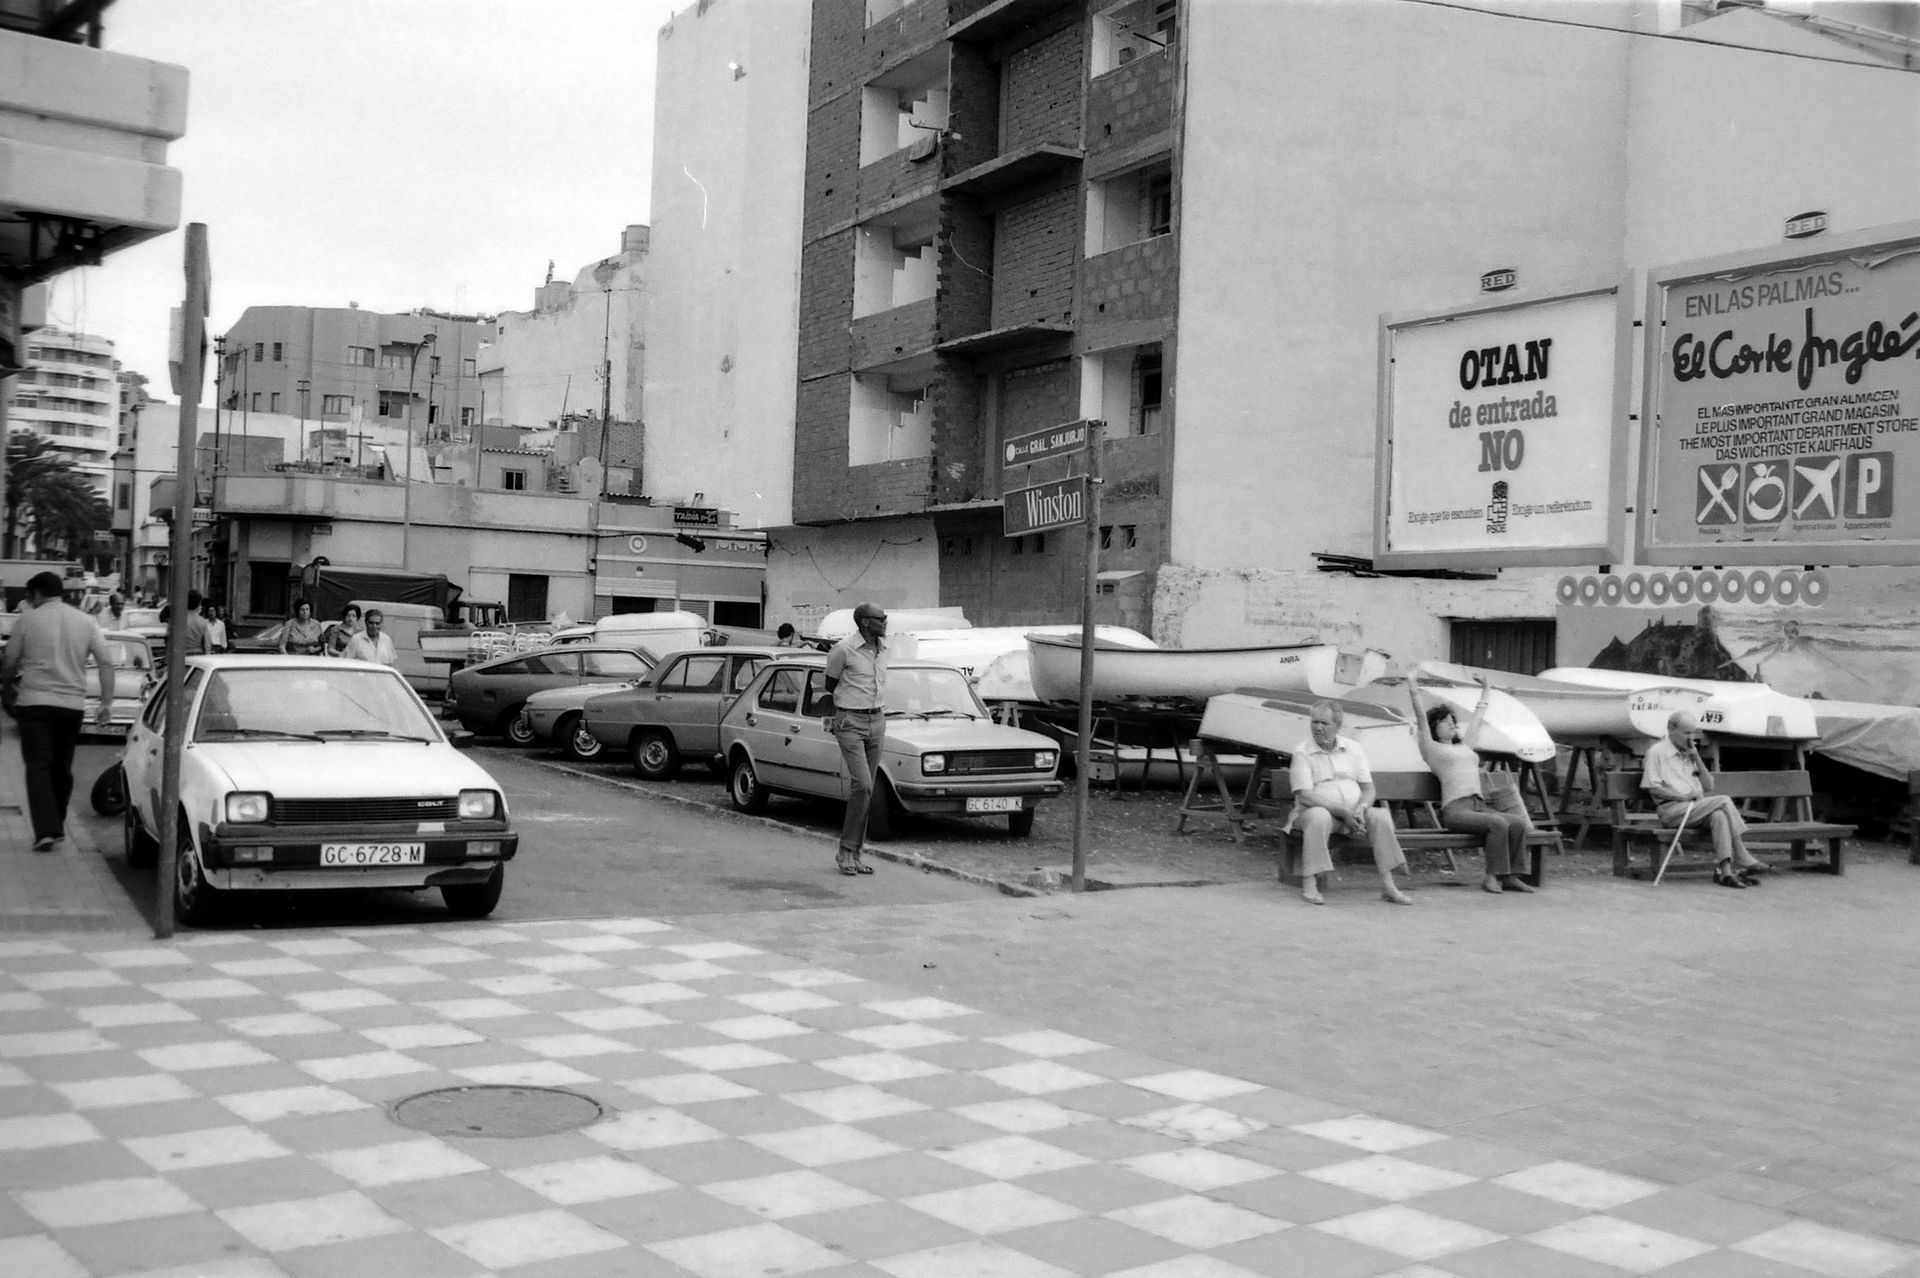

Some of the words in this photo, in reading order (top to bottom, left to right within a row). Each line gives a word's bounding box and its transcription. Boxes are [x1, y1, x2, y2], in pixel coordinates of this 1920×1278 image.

[1785, 217, 1826, 234] RED
[1481, 273, 1516, 288] RED
[1686, 294, 1711, 318] EN
[1714, 286, 1755, 315] LAS
[1460, 338, 1552, 391] OTAN
[1672, 332, 1706, 382] El
[1708, 330, 1793, 379] Corte
[1449, 400, 1472, 429] de
[1476, 390, 1558, 426] entrada
[1695, 422, 1709, 435] LE
[1710, 418, 1737, 433] PLUS
[1738, 411, 1801, 431] IMPORTANT
[1801, 409, 1843, 424] GRAND
[1844, 403, 1900, 421] MAGASIN
[1697, 407, 1711, 419] EL
[1735, 399, 1804, 416] IMPORTANTE
[1805, 395, 1838, 409] GRAN
[1840, 389, 1899, 405] ALMACEN
[1029, 438, 1049, 455] GRAL.
[1050, 427, 1085, 449] SANJURJO
[1679, 437, 1700, 450] THE
[1700, 435, 1732, 449] MOST
[1733, 427, 1796, 447] IMPORTANT
[1797, 421, 1875, 440] DEPARTMENT
[1876, 418, 1919, 434] STORE
[1715, 446, 1738, 461] DAS
[1739, 440, 1807, 459] WICHTIGSTE
[1808, 435, 1873, 453] KAUFHAUS
[1478, 428, 1525, 473] NO
[1856, 457, 1882, 515] P
[1024, 485, 1082, 528] Winston
[1486, 523, 1507, 534] PSOE
[417, 800, 445, 808] COLT
